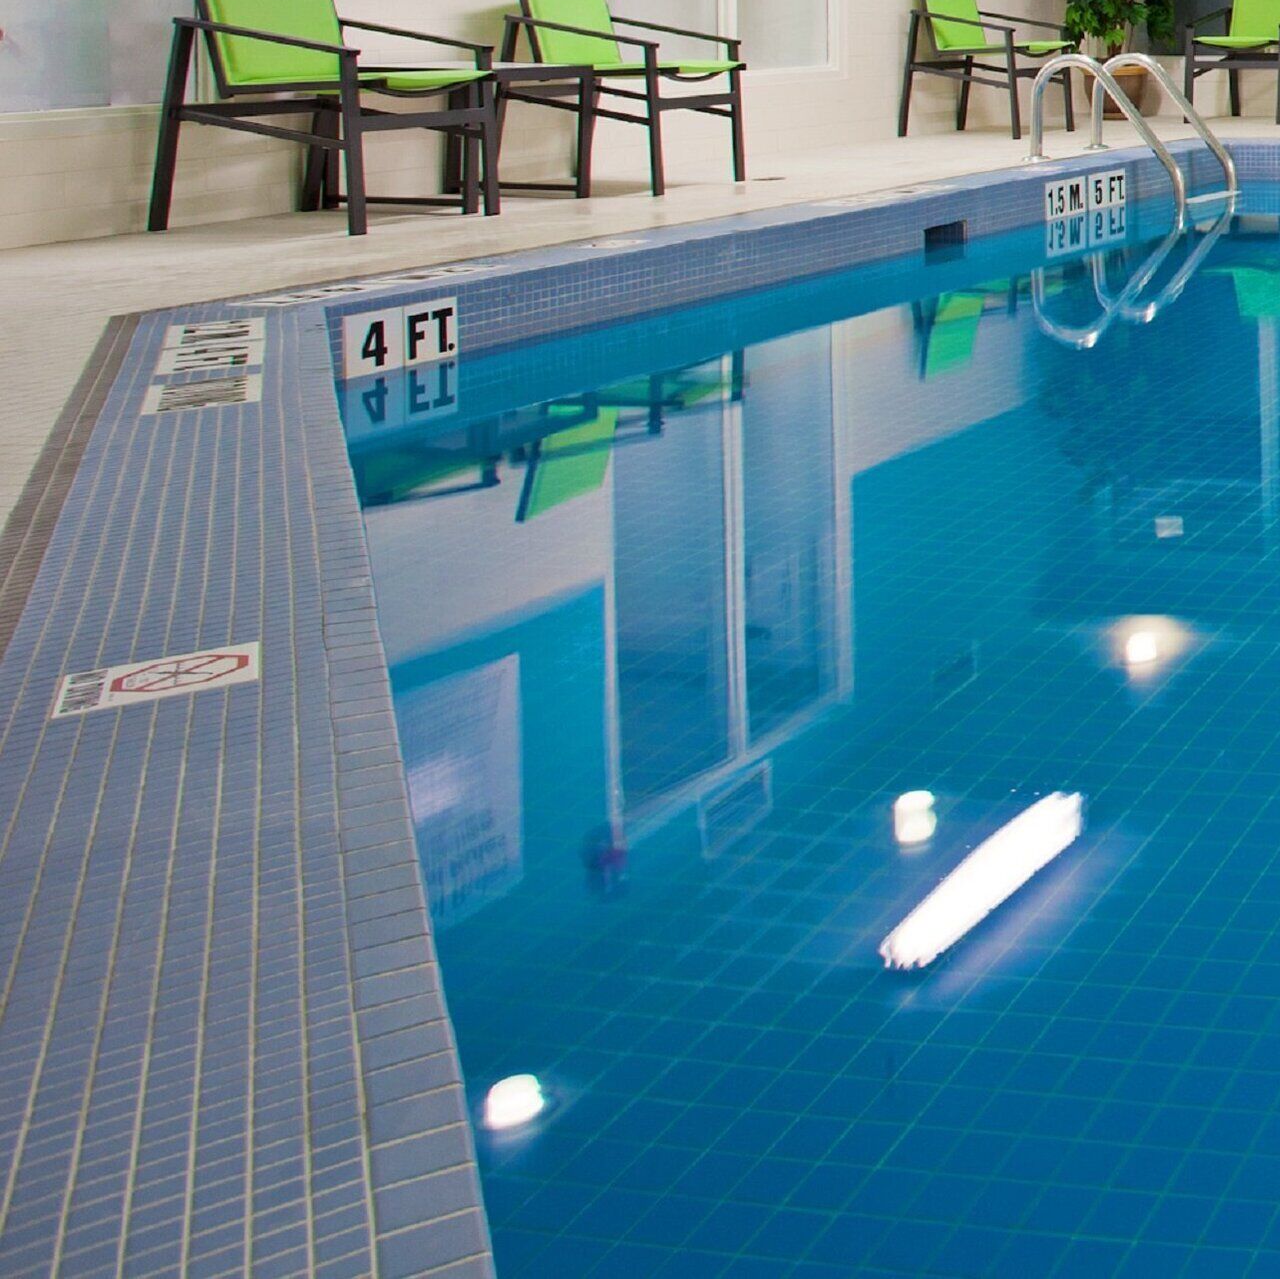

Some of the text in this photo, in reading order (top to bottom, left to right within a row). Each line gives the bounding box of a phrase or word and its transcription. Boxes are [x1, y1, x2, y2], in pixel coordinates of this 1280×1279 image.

[1048, 175, 1125, 216] 1.5 M. 5 FT.
[362, 306, 456, 367] 4 FT.
